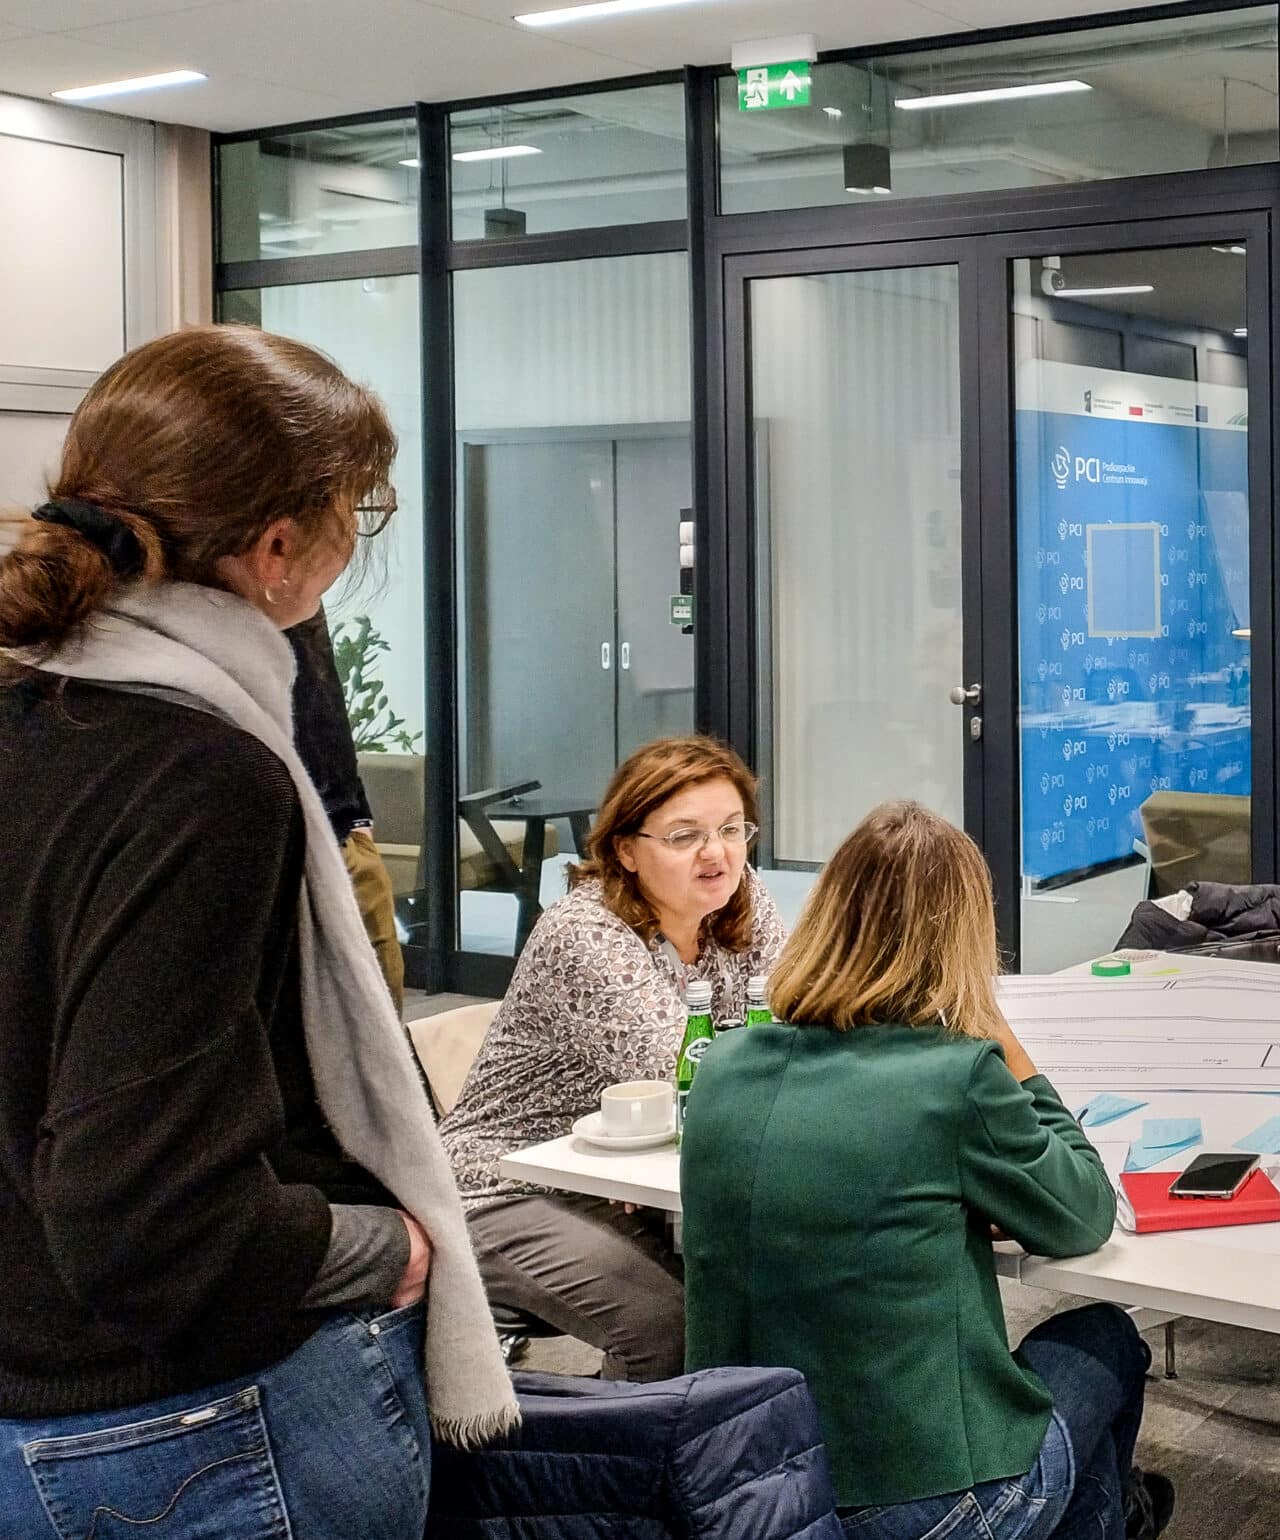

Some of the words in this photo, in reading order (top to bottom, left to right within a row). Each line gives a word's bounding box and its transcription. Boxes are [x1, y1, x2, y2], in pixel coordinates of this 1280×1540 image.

[1075, 456, 1100, 483] PCI
[1069, 523, 1082, 537] PCI
[1070, 577, 1083, 590] PCI
[1196, 572, 1208, 585] PCI
[1071, 632, 1085, 646] PCI
[1073, 687, 1086, 700] PCI
[1117, 681, 1129, 695] PCI
[1117, 733, 1130, 746] PCI
[1074, 741, 1087, 755] PCI
[1119, 785, 1131, 799] PCI
[1074, 795, 1088, 811] PCI
